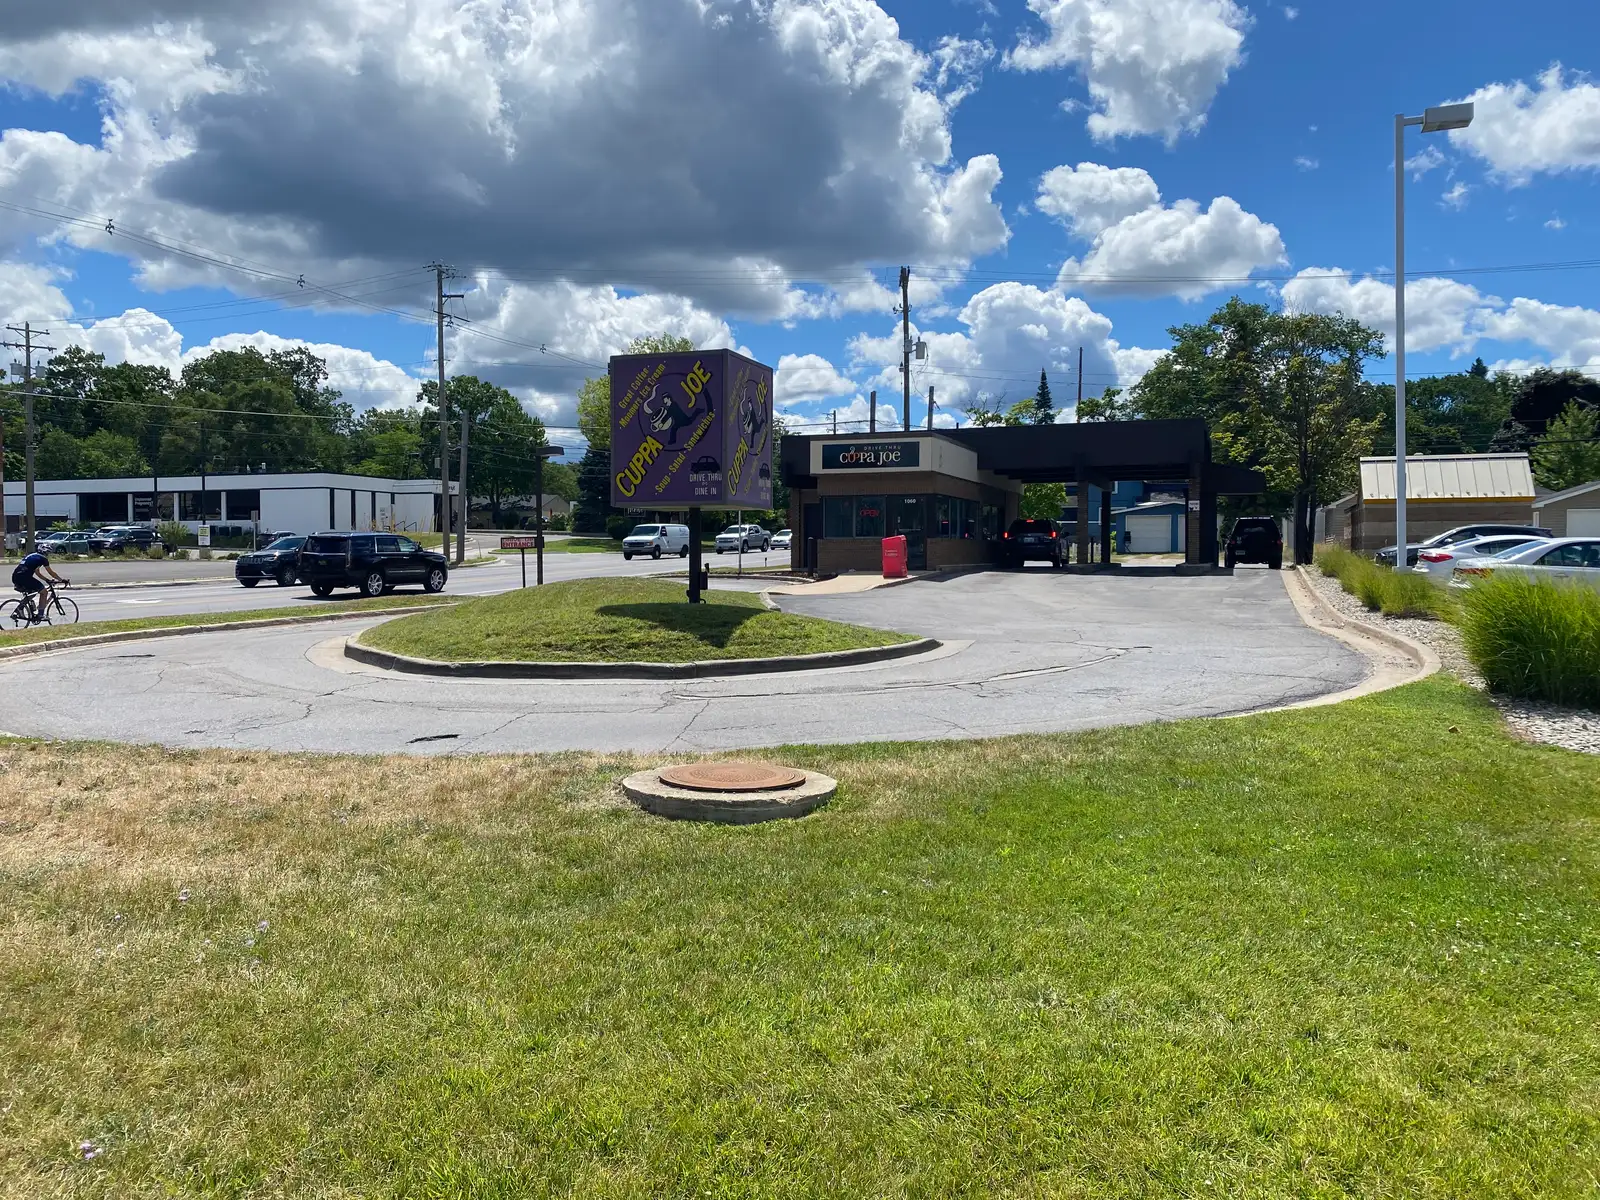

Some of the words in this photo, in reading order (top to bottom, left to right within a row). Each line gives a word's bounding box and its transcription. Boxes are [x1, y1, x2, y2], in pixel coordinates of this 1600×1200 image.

[618, 389, 635, 409] Great
[630, 367, 650, 391] Coffee
[618, 396, 643, 428] Moomers
[639, 385, 651, 398] Ice
[647, 363, 666, 386] Cream
[616, 436, 664, 496] CUPPA
[680, 360, 712, 409] JOE
[655, 474, 671, 493] Soup
[668, 452, 686, 473] Salad
[683, 411, 716, 451] Sandwiches
[689, 473, 706, 482] DRIVE
[707, 472, 723, 481] THRU
[694, 487, 708, 495] DINE
[710, 487, 717, 495] IN
[728, 436, 749, 496] CUPPA
[860, 509, 880, 517] OPEN
